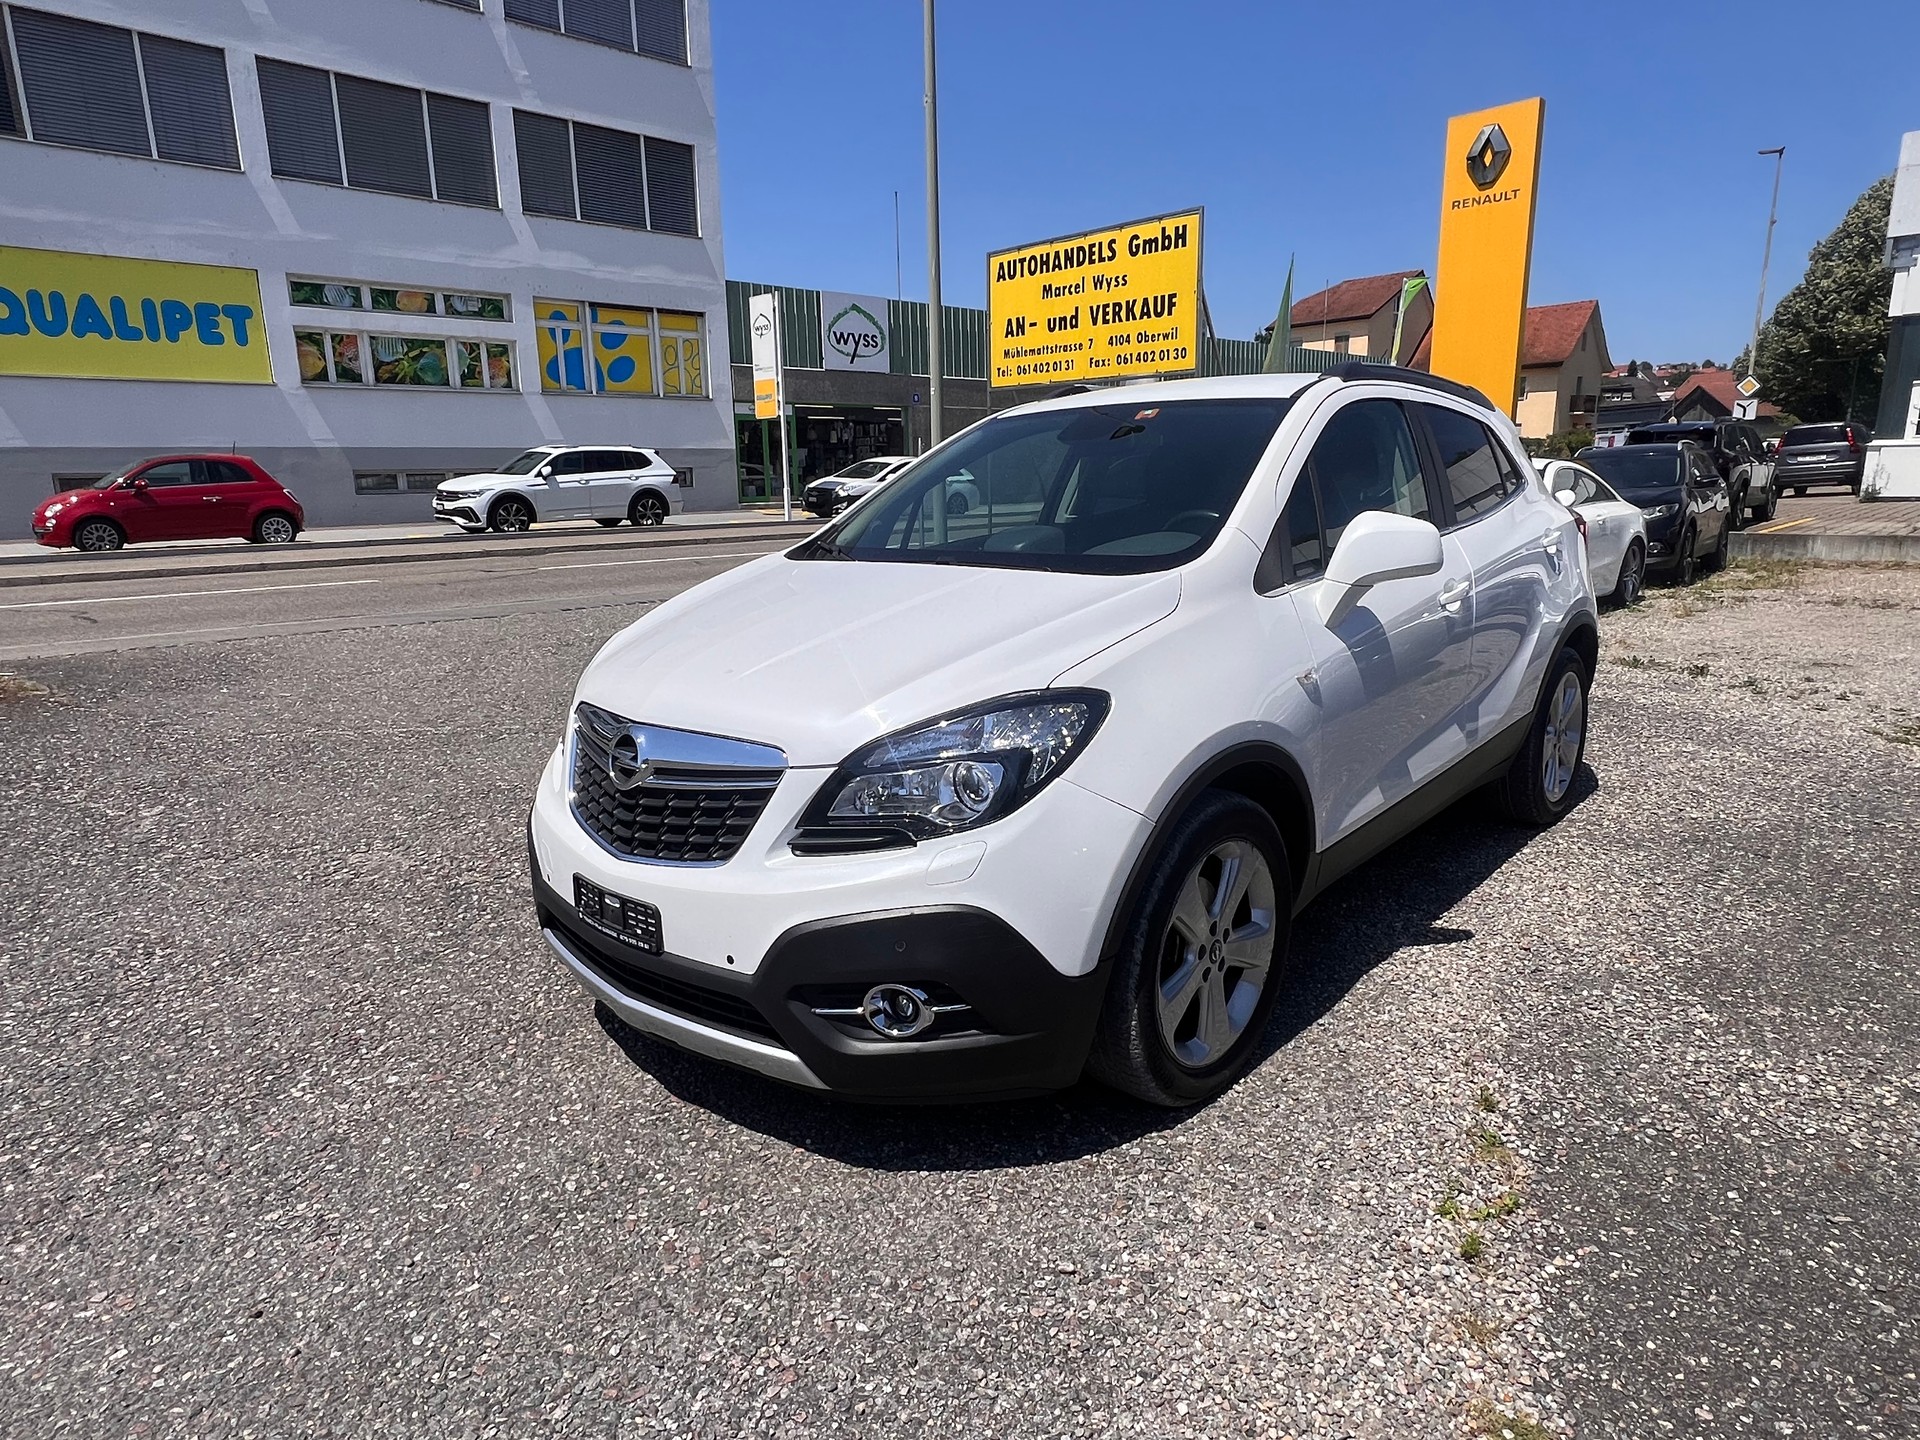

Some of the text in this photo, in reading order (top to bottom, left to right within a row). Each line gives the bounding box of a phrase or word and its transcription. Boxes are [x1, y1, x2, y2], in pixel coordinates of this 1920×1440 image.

[1452, 189, 1520, 210] RENAULT
[996, 223, 1188, 283] AUTOHANDELS GmbH
[1041, 274, 1128, 300] Marcel Wyss
[0, 287, 254, 347] QUALIPET
[1047, 306, 1079, 333] und
[1089, 292, 1178, 327] VERKAUF
[832, 330, 879, 365] wyss
[1003, 326, 1178, 360] Mühlemattstrasse 7 4104 Oberwil
[996, 365, 1013, 378] Tel:
[1089, 357, 1111, 369] Fax:
